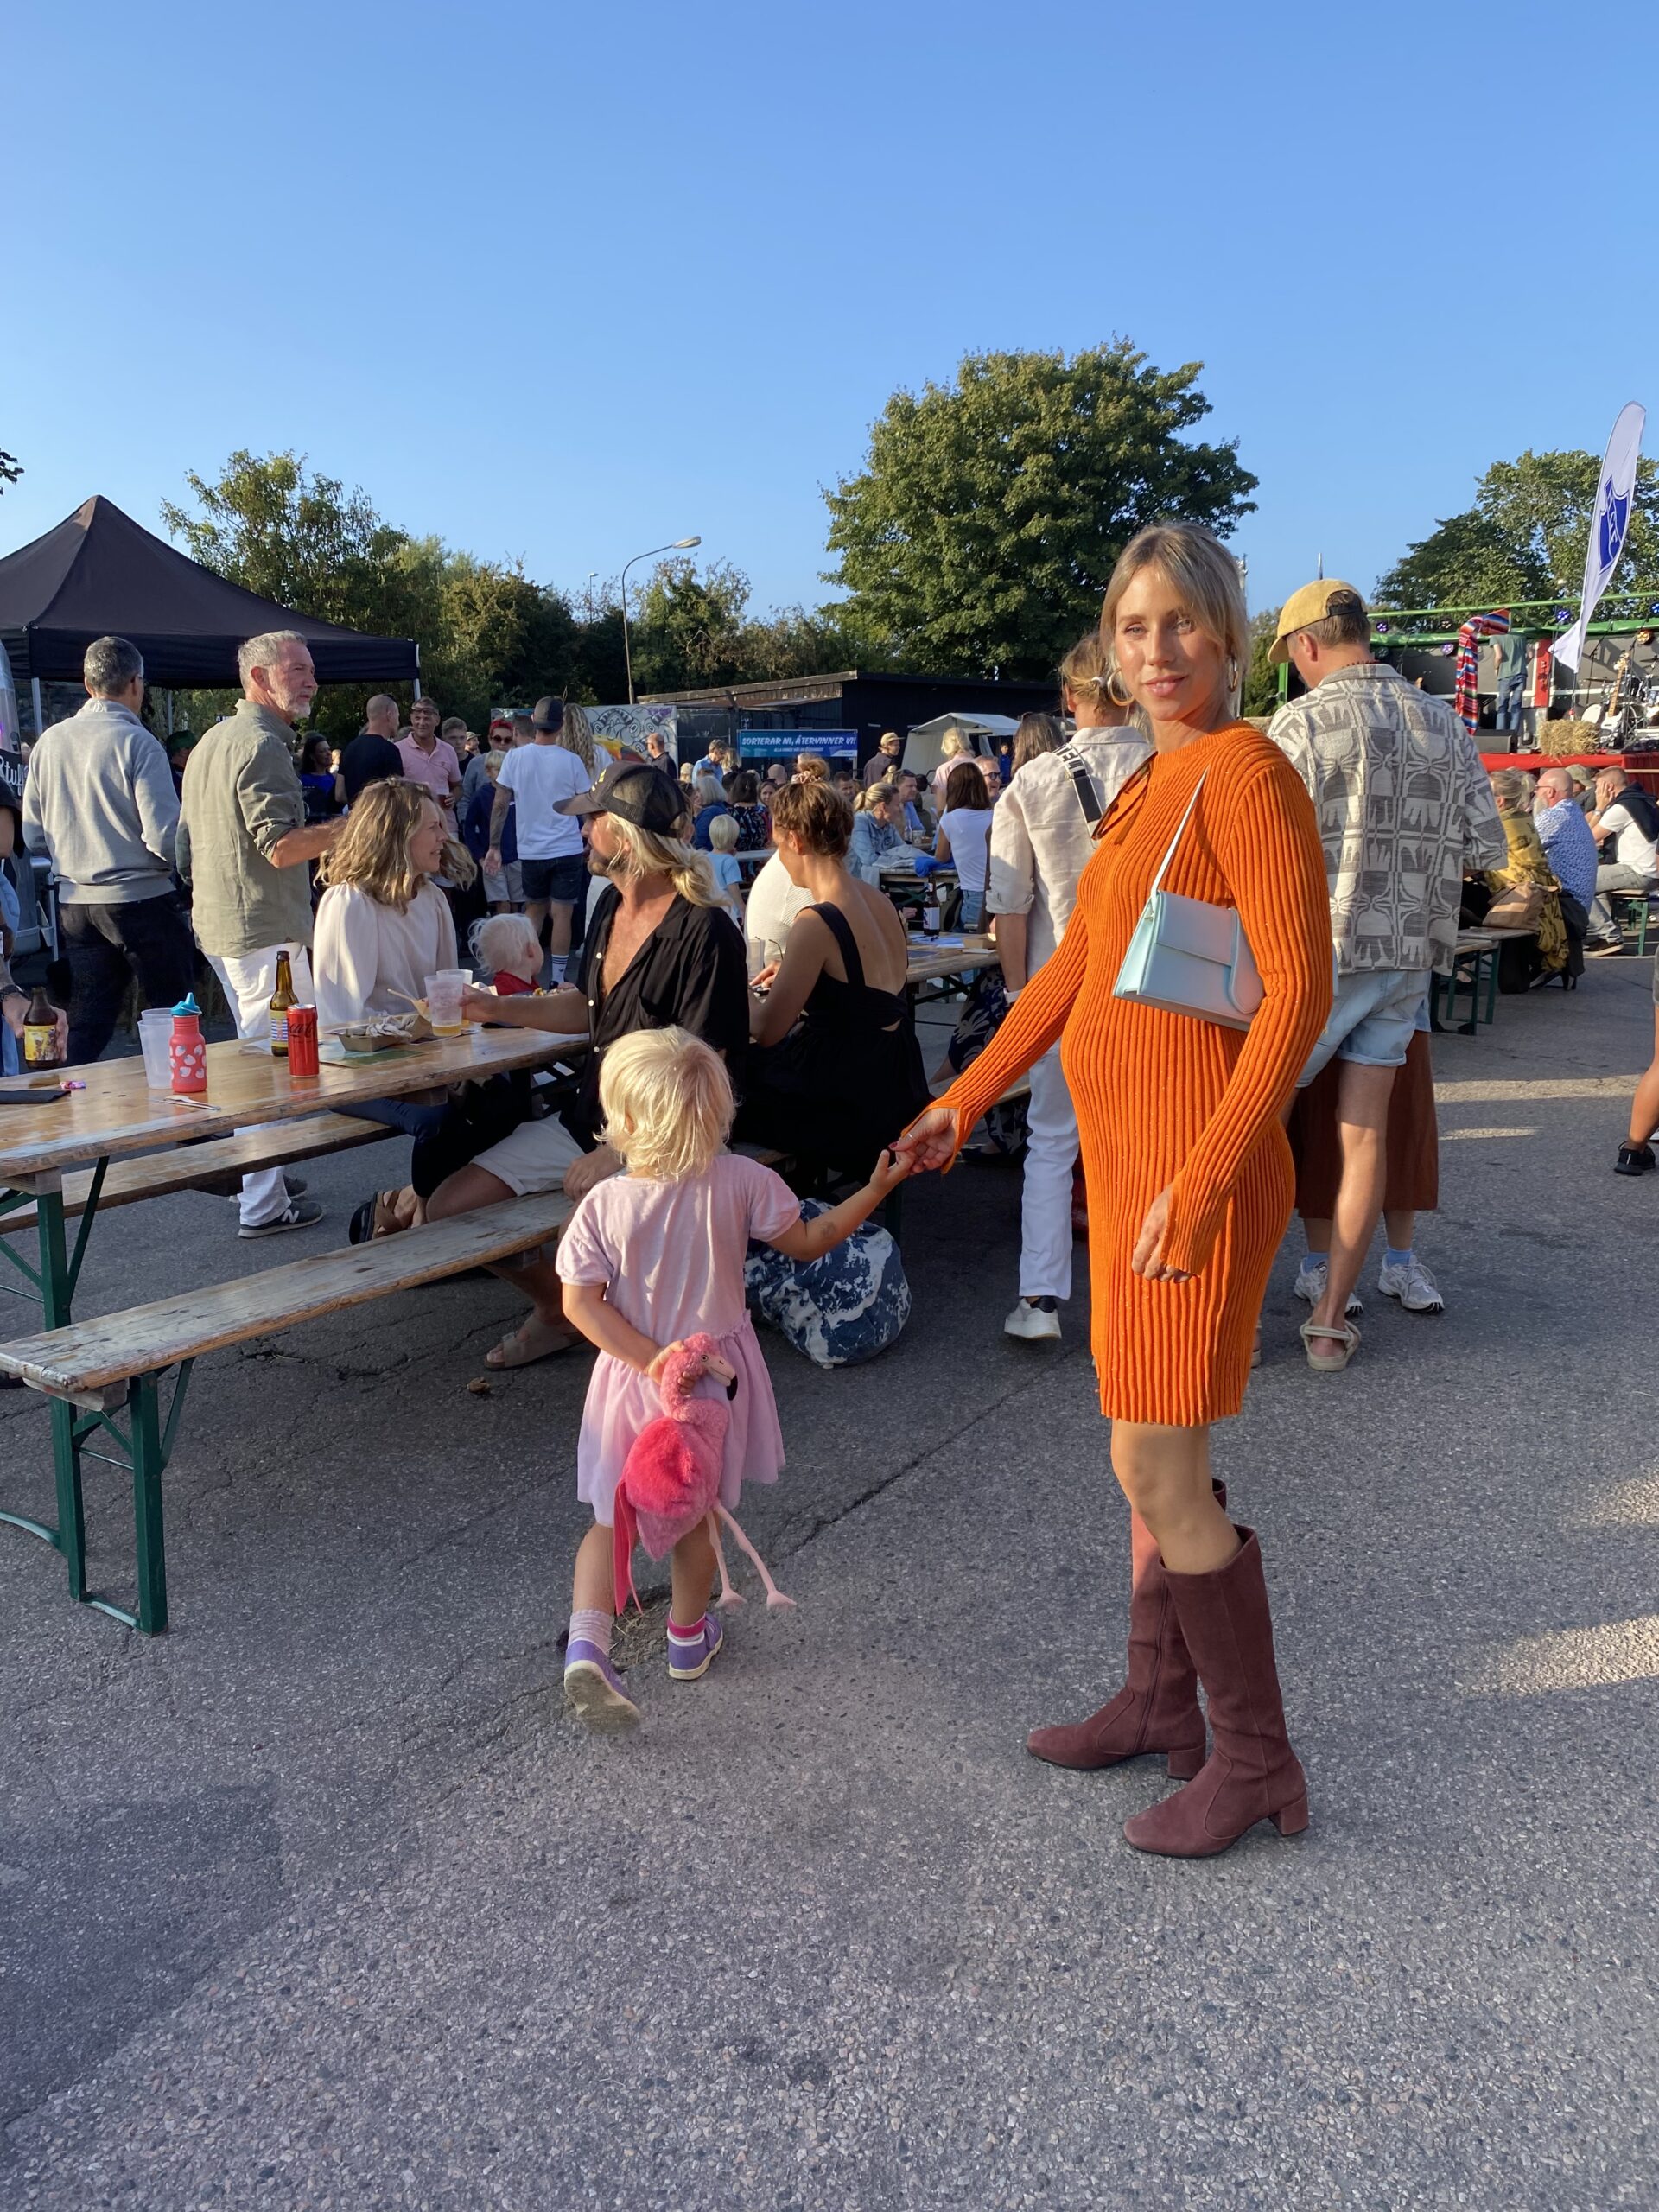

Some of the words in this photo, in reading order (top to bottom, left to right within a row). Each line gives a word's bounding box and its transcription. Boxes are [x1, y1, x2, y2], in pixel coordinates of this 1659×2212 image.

[782, 737, 793, 746] NI,
[795, 734, 844, 745] ÅTERVINNER
[281, 1209, 300, 1224] N
